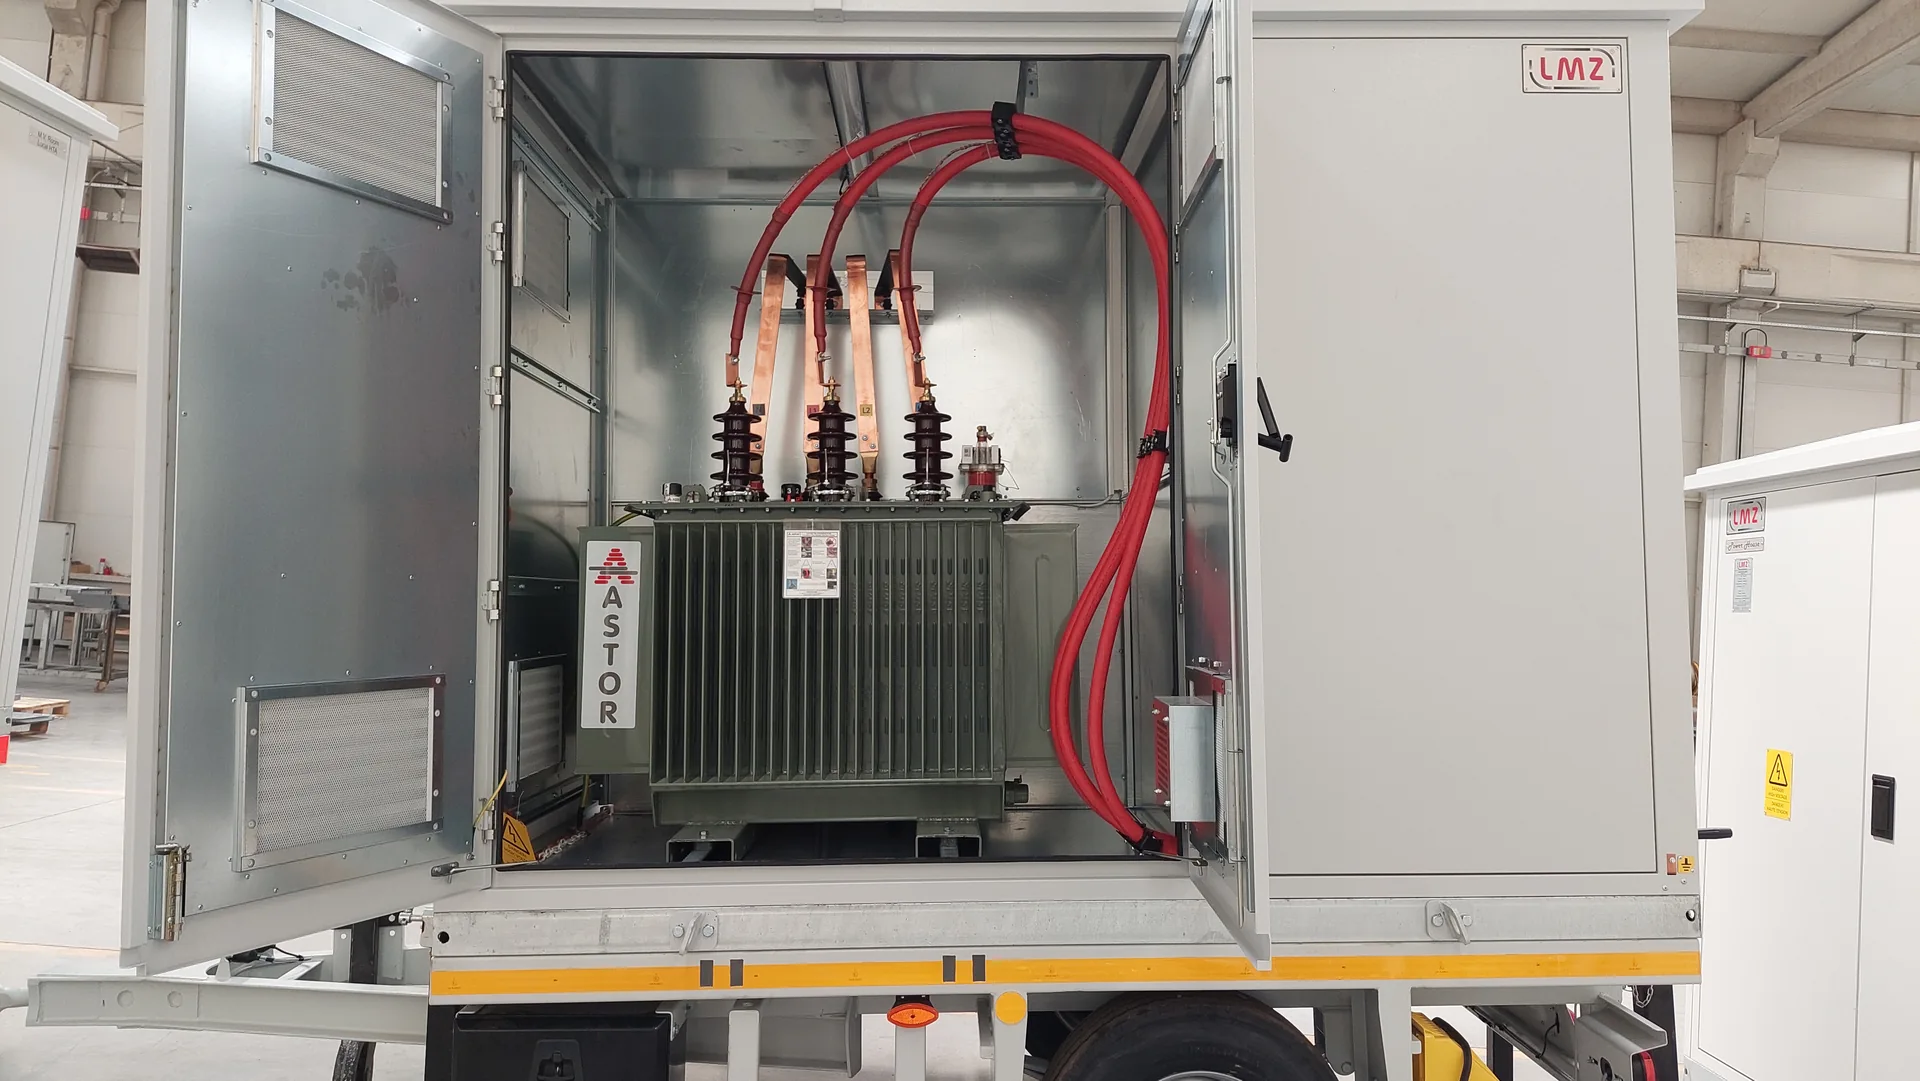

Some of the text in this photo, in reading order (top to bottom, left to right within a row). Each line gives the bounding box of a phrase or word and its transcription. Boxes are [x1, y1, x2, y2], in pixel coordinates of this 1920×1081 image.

[1540, 57, 1604, 81] LMZ
[1733, 506, 1759, 526] LMZ
[598, 585, 623, 724] ASTOR
